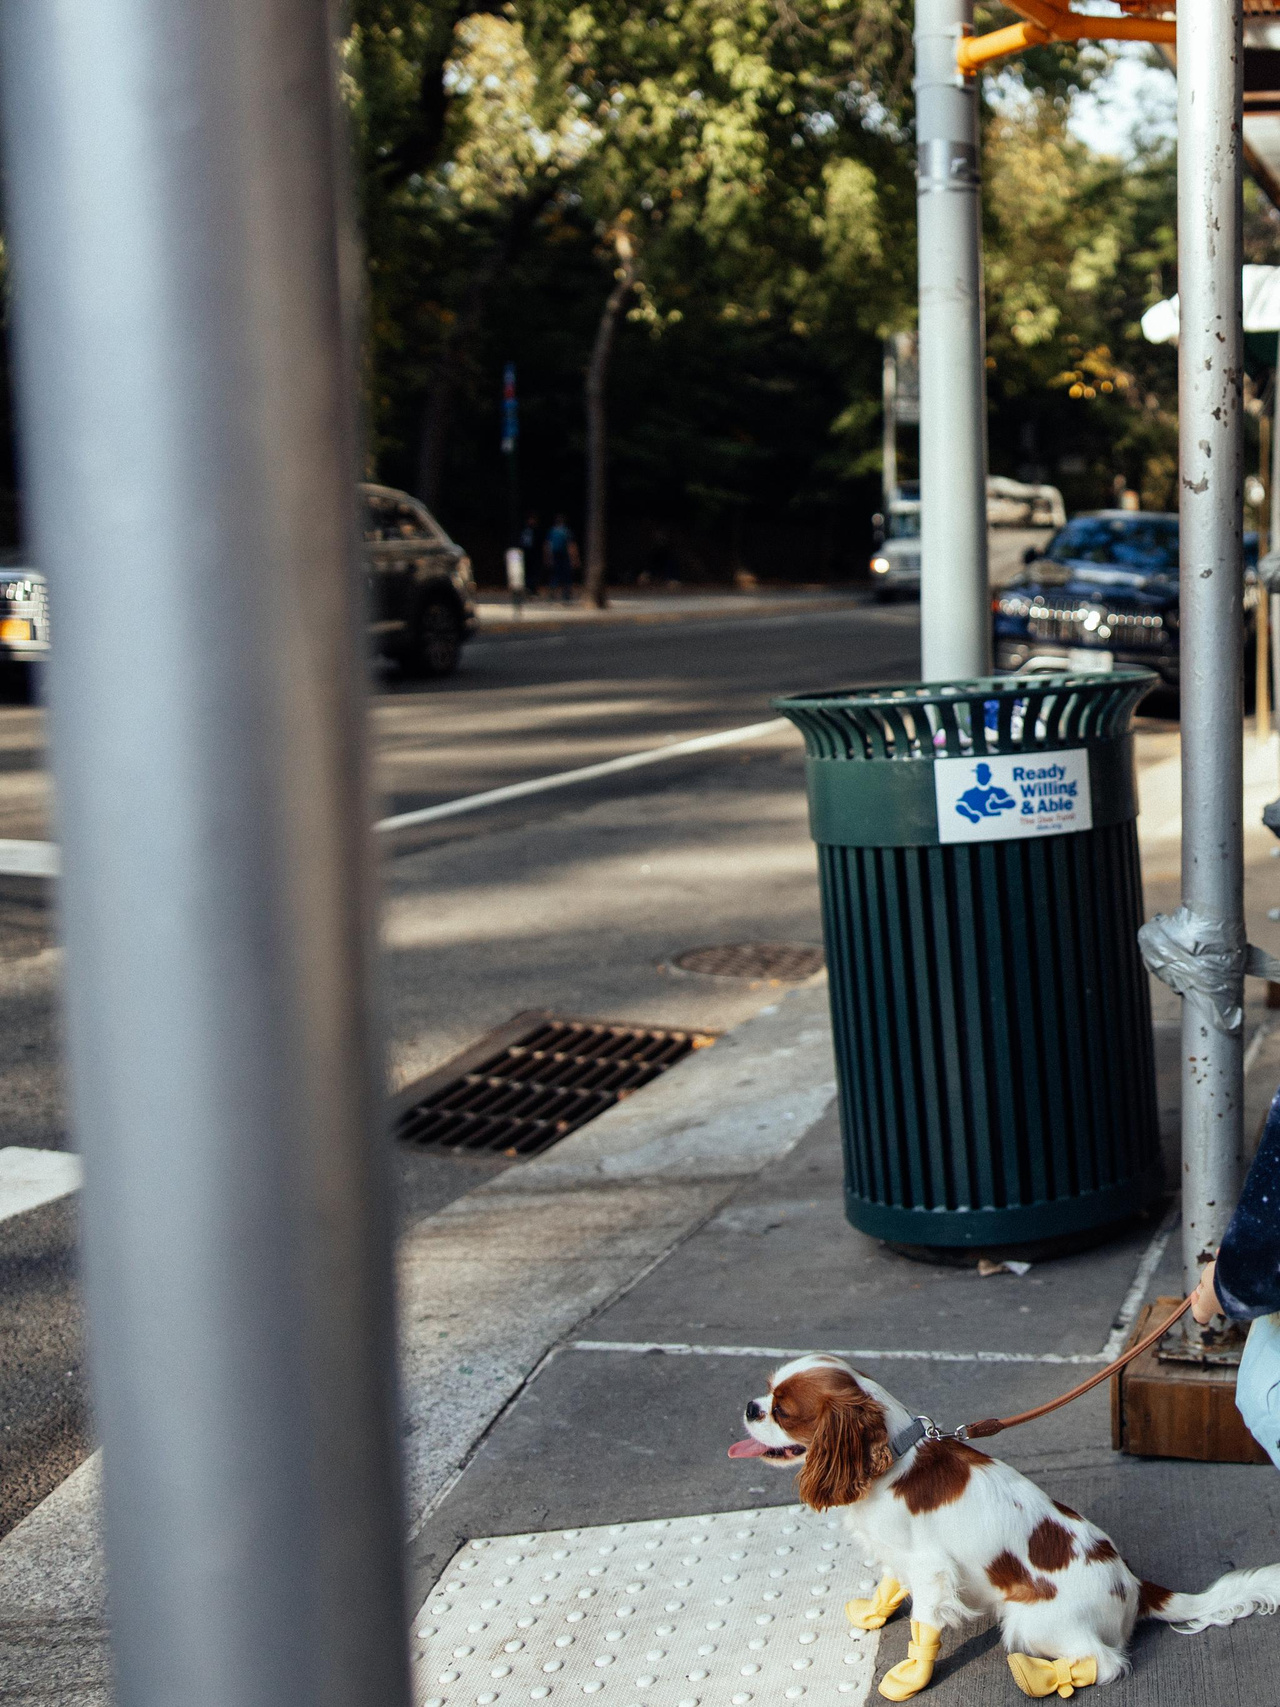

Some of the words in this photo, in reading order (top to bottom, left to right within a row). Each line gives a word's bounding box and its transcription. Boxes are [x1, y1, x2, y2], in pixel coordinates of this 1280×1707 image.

[1013, 763, 1066, 781] Ready
[1020, 780, 1077, 797] Willing
[1021, 800, 1034, 815] &
[1037, 798, 1073, 813] Able
